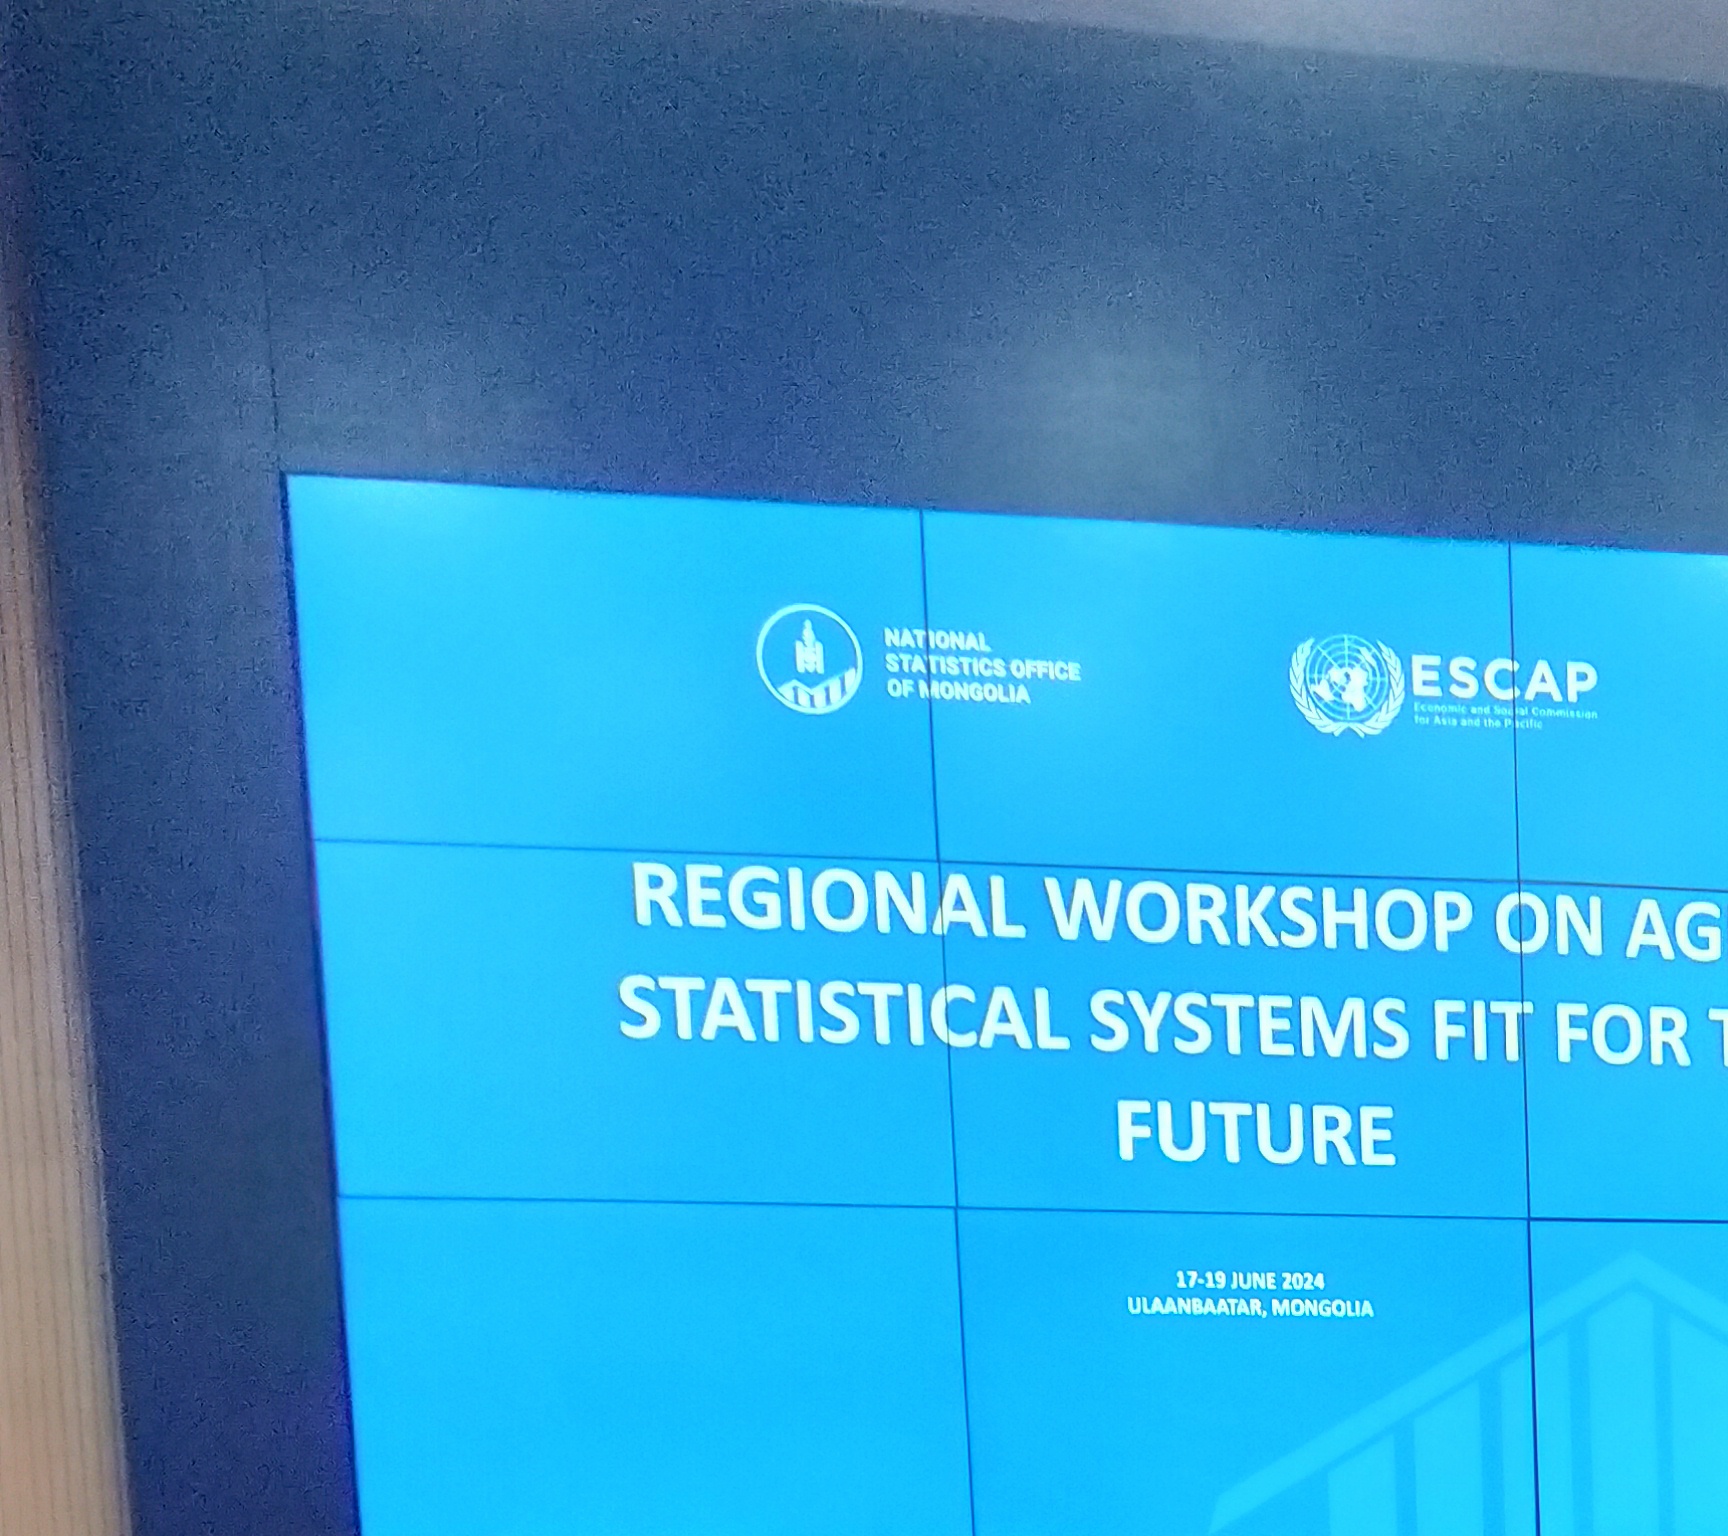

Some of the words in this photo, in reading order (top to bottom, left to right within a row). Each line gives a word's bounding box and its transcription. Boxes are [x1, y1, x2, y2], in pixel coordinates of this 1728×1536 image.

[883, 627, 991, 652] NATIONAL
[885, 653, 1007, 678] STATISTICS
[1010, 659, 1082, 681] OFFICE
[1411, 654, 1598, 703] ESCAP
[887, 678, 914, 698] OF
[918, 679, 1031, 704] MONGOLIA
[1414, 702, 1467, 715] Economic
[1470, 706, 1490, 716] and
[1494, 705, 1528, 716] Social
[1532, 706, 1598, 720] Commission
[1414, 714, 1429, 725] for
[1433, 715, 1458, 726] Asia
[1460, 717, 1480, 727] and
[1484, 717, 1500, 728] the
[1505, 719, 1543, 730] Pacific
[632, 861, 1026, 938] REGIONAL
[1044, 877, 1473, 952] WORKSHOP
[1495, 892, 1603, 956] ON
[619, 974, 1071, 1050] STATISTICAL
[1090, 989, 1410, 1060] SYSTEMS
[1434, 999, 1532, 1062] FIT
[1556, 1002, 1692, 1067] FOR
[1117, 1100, 1396, 1166] FUTURE
[1176, 1270, 1226, 1289] 17-19
[1231, 1271, 1277, 1290] JUNE
[1281, 1272, 1325, 1291] 2024
[1127, 1296, 1267, 1318] ULAANBAATAR,
[1272, 1298, 1374, 1318] MONGOLIA
